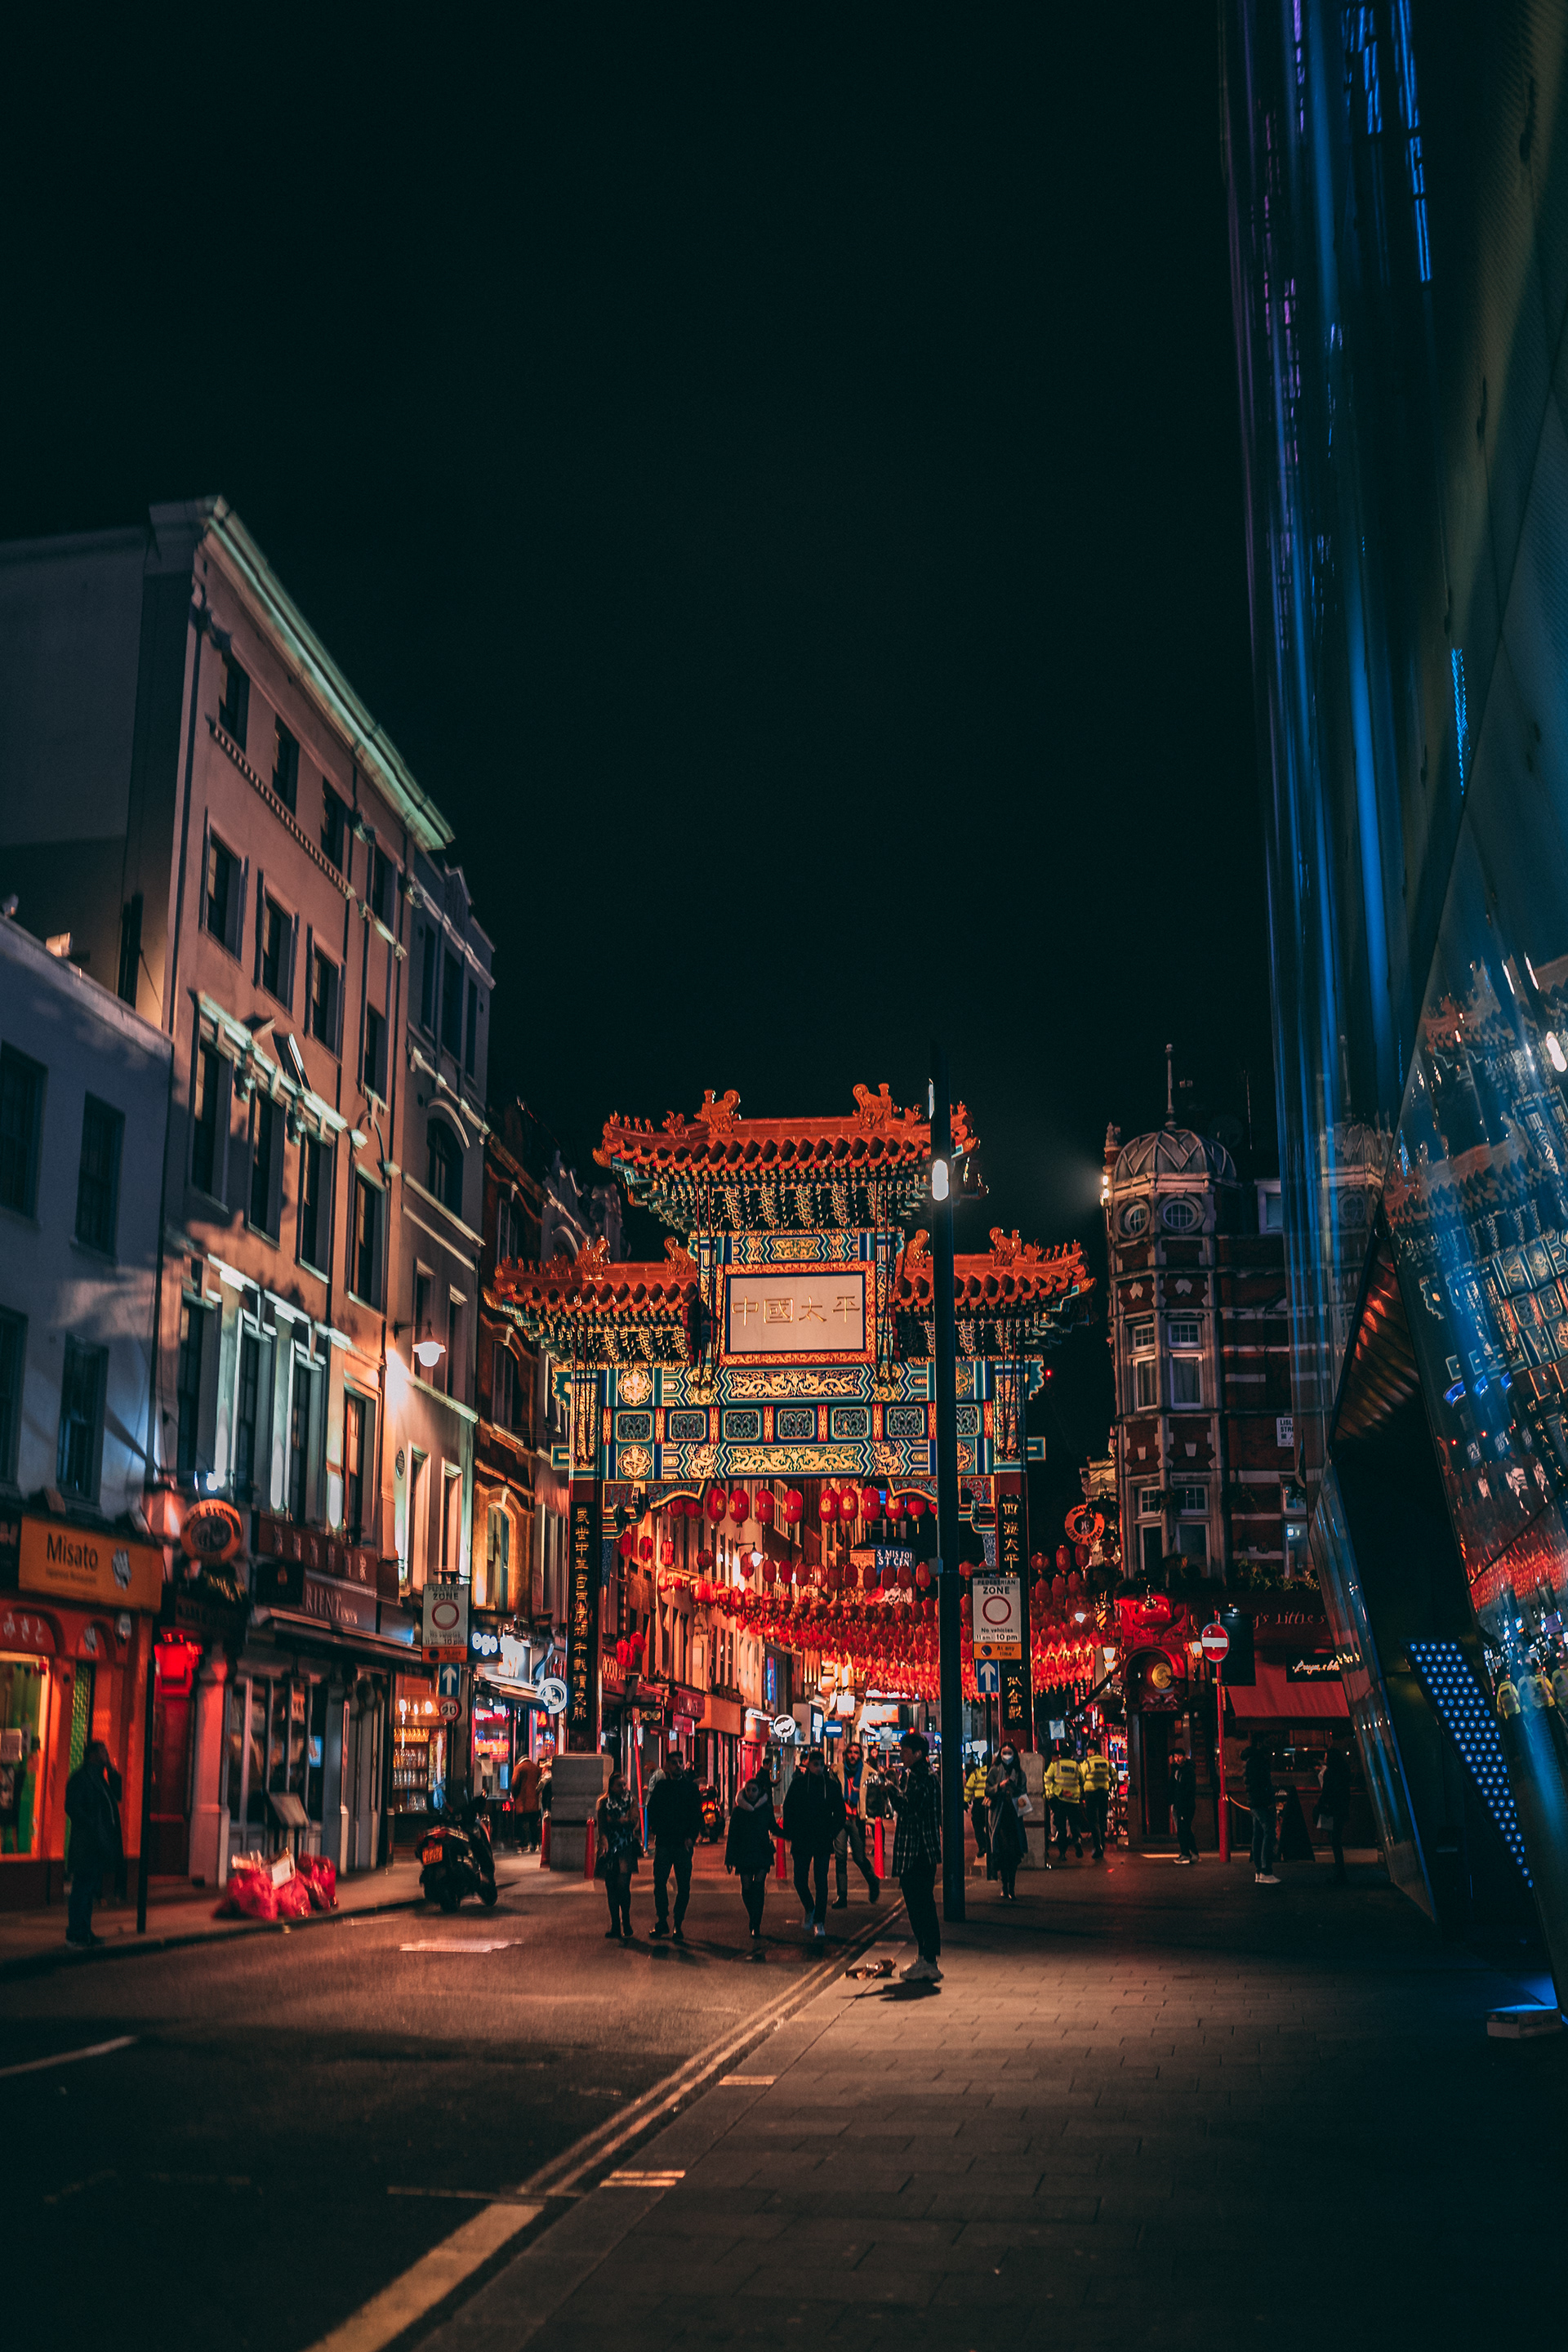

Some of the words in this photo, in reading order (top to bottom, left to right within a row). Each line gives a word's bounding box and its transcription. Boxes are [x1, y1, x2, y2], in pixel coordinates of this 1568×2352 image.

[731, 1295, 861, 1326] 中國太平
[46, 1532, 99, 1572] Misato
[433, 1592, 459, 1601] ZONE
[982, 1586, 1010, 1595] ZONE
[1275, 1610, 1314, 1624] Little
[441, 1704, 457, 1716] 20
